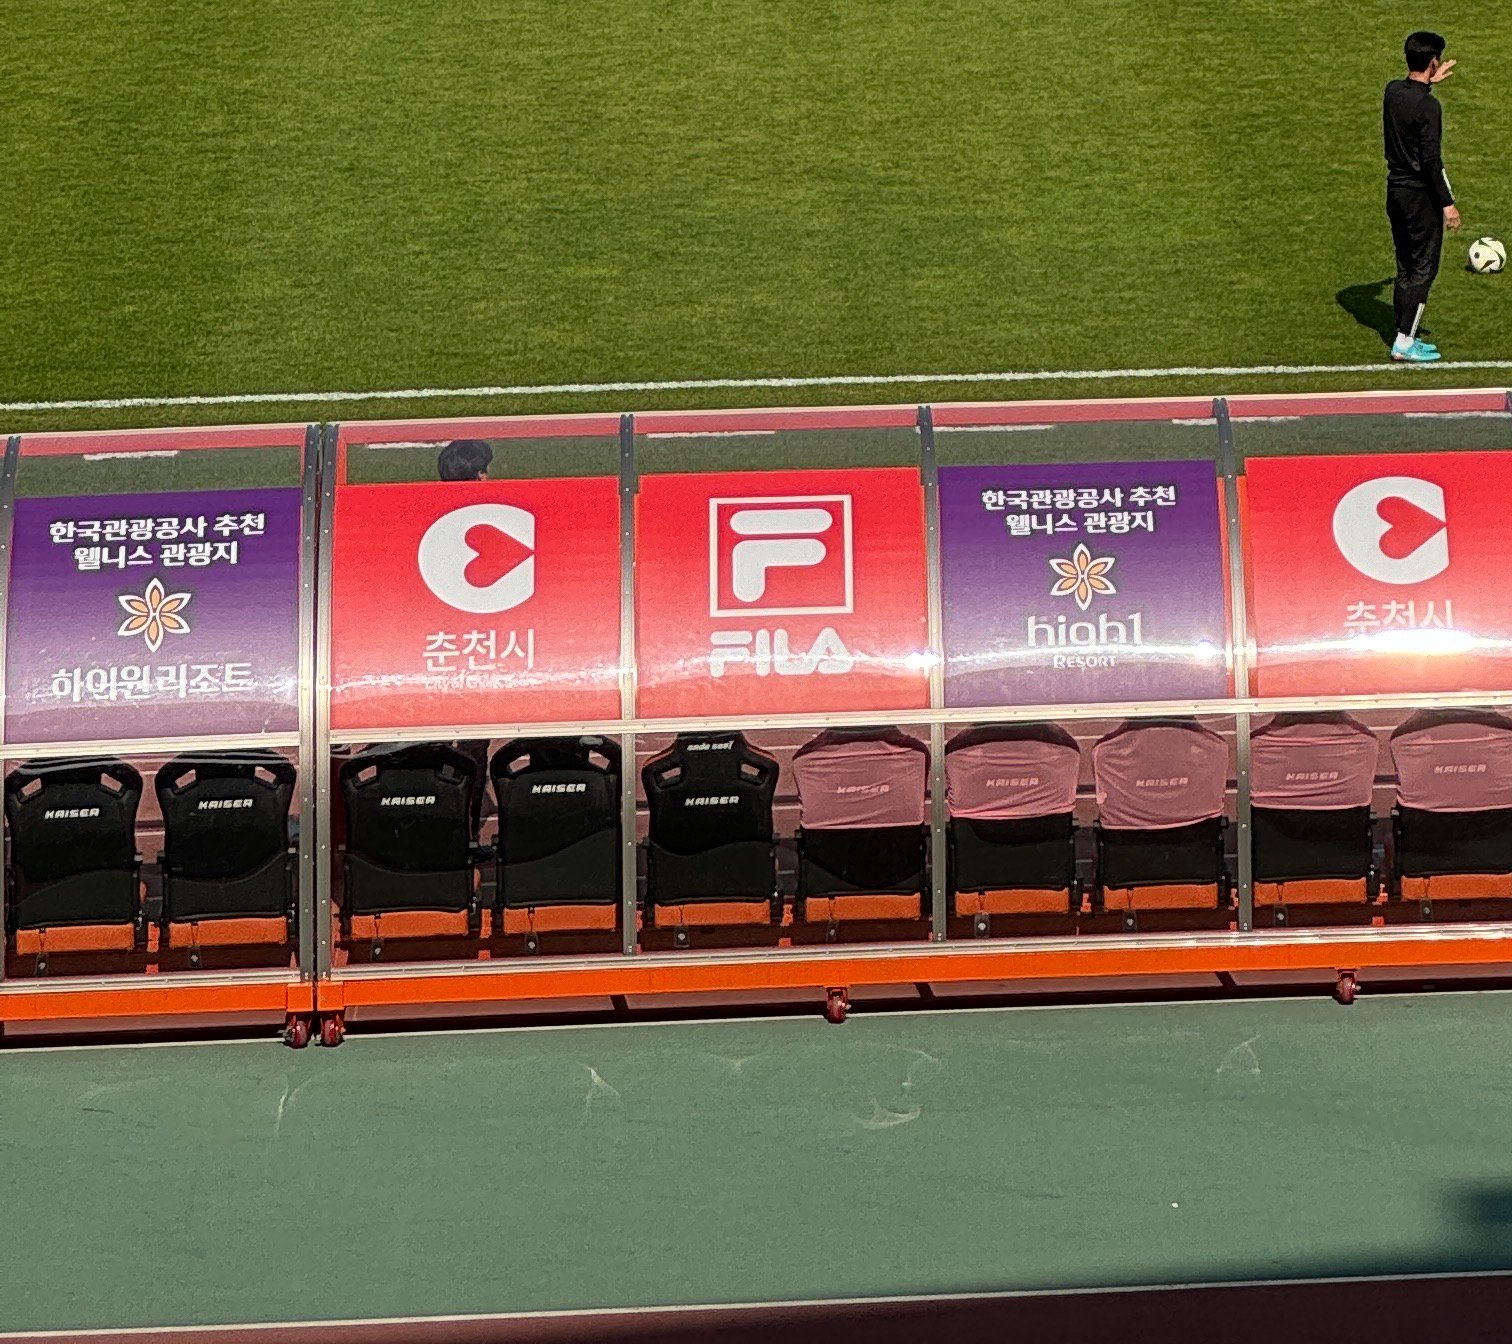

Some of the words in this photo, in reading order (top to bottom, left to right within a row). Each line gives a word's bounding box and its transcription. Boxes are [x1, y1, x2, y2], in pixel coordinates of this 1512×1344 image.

[982, 487, 1124, 510] 한국관광공사
[1129, 485, 1177, 507] 추천
[49, 515, 207, 543] 한국관광공사
[212, 512, 265, 535] 추천
[1006, 513, 1078, 536] 웰니스
[1083, 510, 1154, 533] 관광지
[74, 545, 153, 570] 웰니스
[159, 541, 238, 566] 관광지
[422, 628, 535, 671] 춘천시
[710, 626, 854, 678] FILA
[380, 795, 436, 807] KAISER
[531, 783, 586, 794] KAISER
[685, 795, 739, 806] KAISER
[45, 807, 100, 819] KAISER
[198, 798, 253, 810] KAISER
